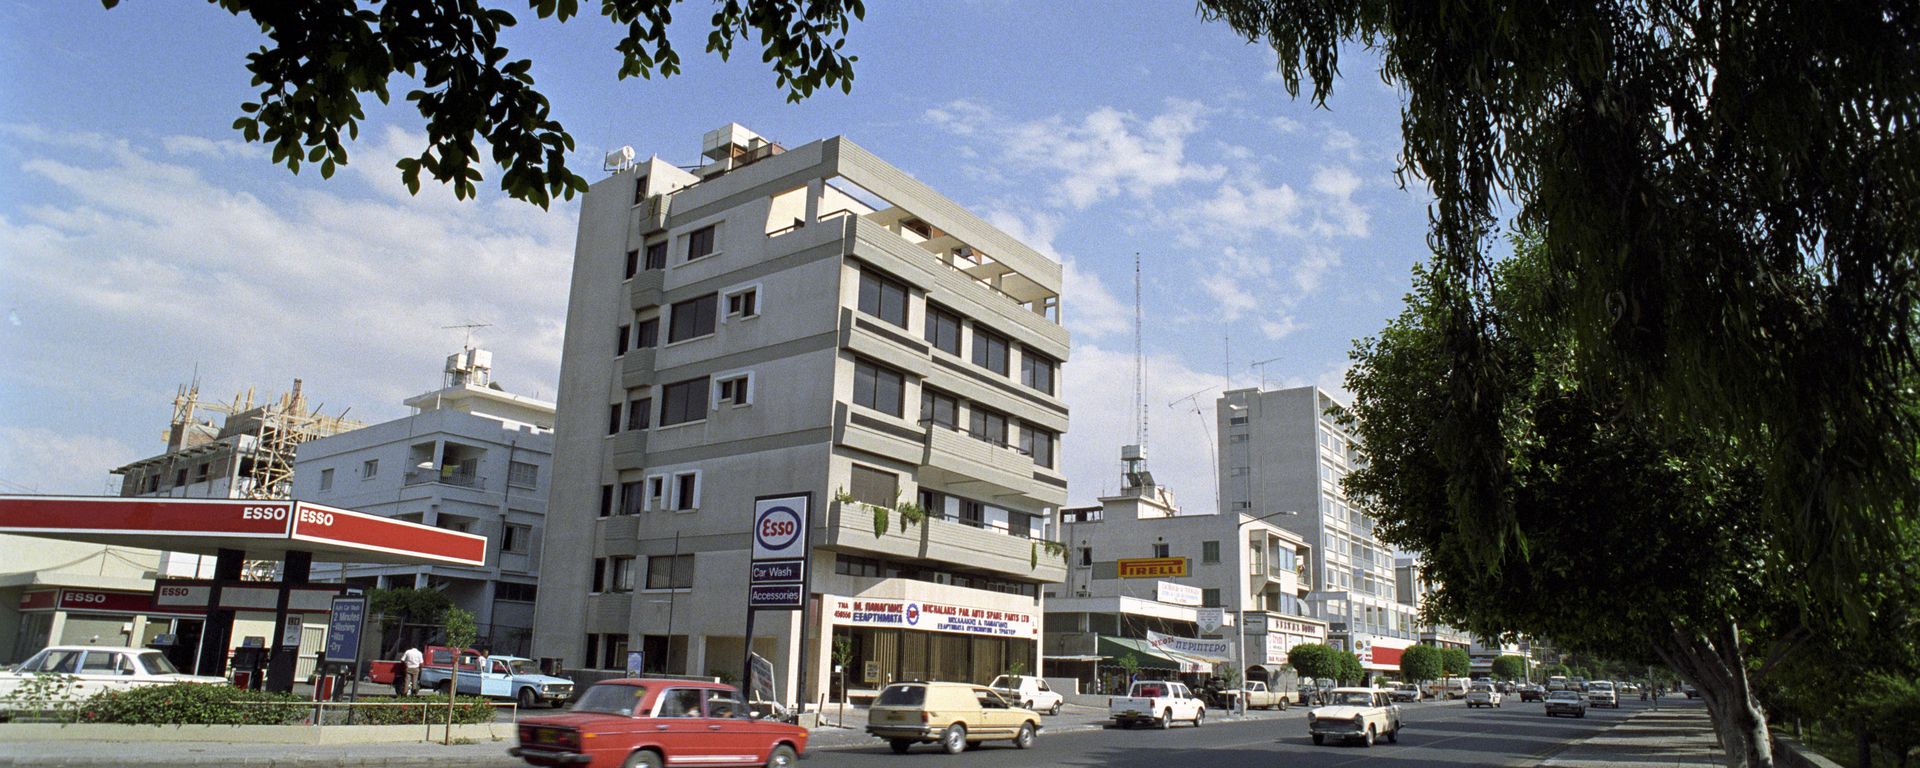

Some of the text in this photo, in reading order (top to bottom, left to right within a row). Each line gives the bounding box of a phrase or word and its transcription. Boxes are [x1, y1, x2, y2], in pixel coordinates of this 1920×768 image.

[243, 507, 286, 520] ESSO
[300, 509, 334, 526] ESSO
[762, 519, 794, 537] Esso
[753, 566, 792, 577] Car Wash
[1120, 560, 1183, 575] PIRELLI
[65, 592, 106, 603] ESSO
[160, 588, 189, 596] ESSO
[752, 590, 799, 600] Accessories
[971, 608, 984, 618] AUTO
[986, 610, 1002, 621] SPARE
[1004, 613, 1020, 622] PARTS
[1020, 615, 1030, 623] LTD
[1175, 640, 1227, 653] ΠΕΡΙΠΤΕΡΟ
